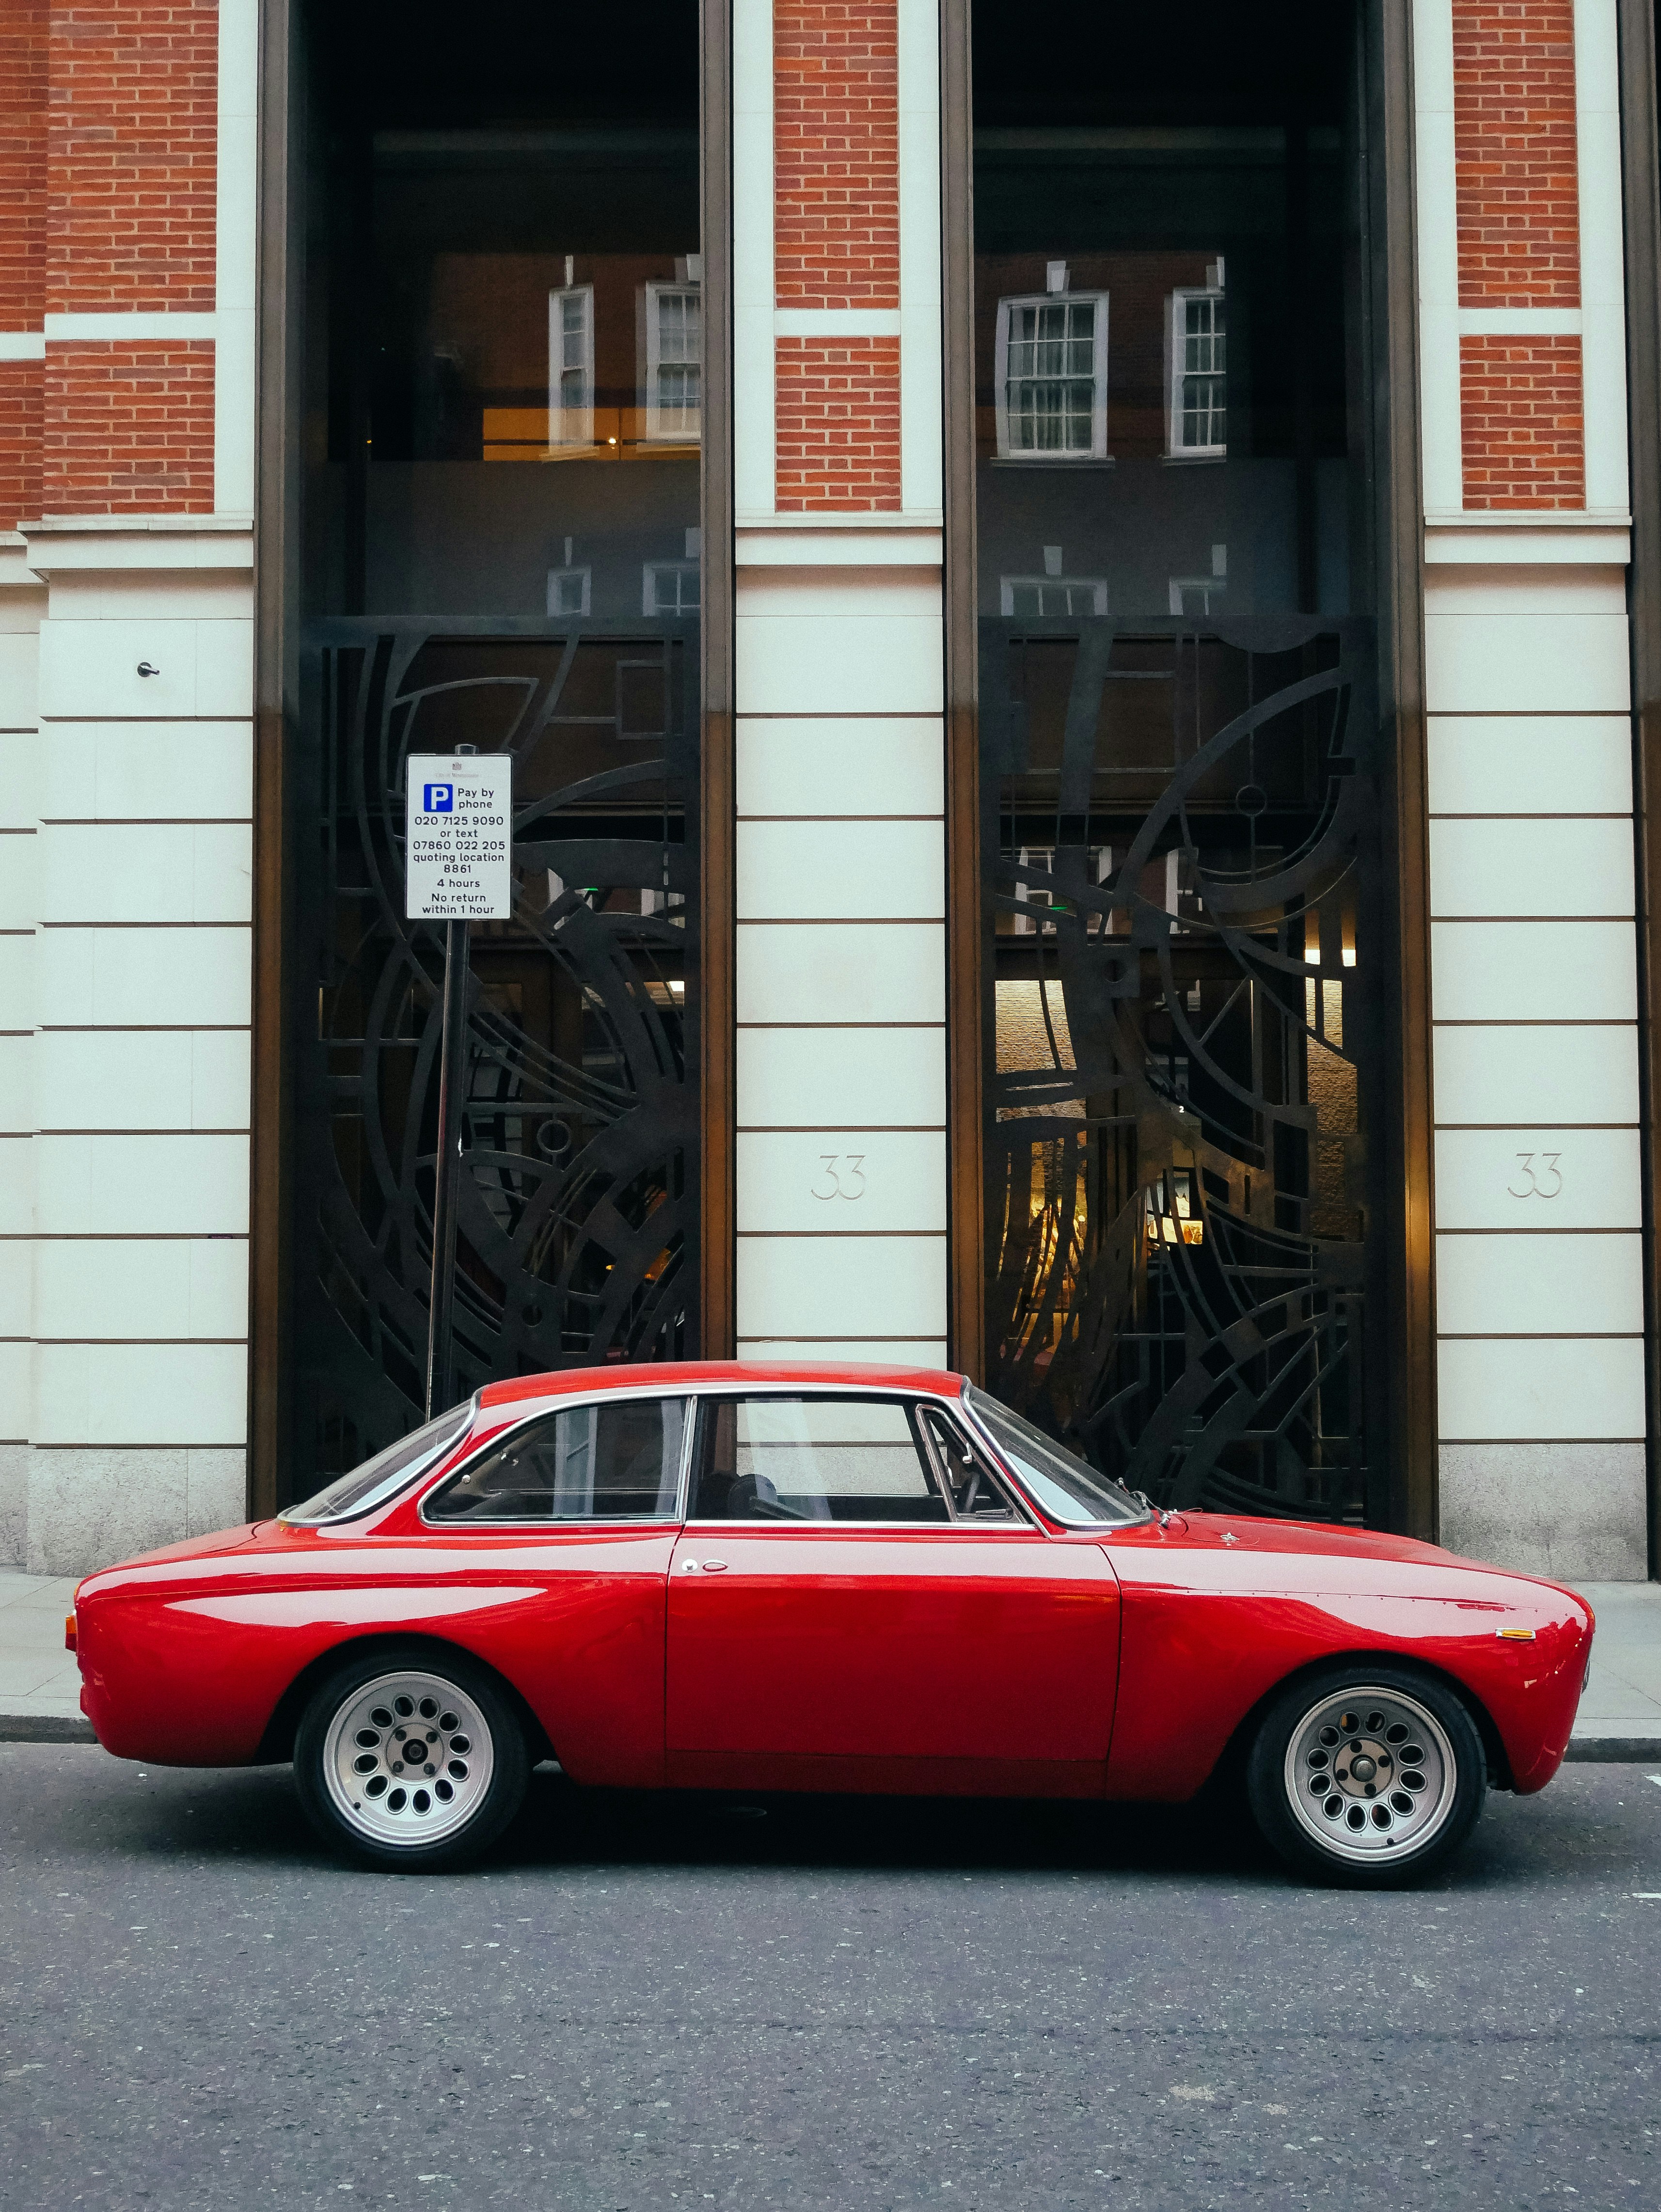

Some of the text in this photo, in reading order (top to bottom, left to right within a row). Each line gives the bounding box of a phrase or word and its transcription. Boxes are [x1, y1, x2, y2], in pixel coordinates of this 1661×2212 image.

[458, 788, 494, 798] Pay by
[430, 787, 449, 810] P
[459, 800, 493, 809] phone
[414, 816, 504, 826] 020 7125 9090
[455, 829, 478, 838] text
[413, 841, 506, 850] 07860 022 205
[413, 852, 505, 863] quoting location
[443, 864, 472, 874] 8861
[437, 879, 480, 888] 4 hours
[431, 893, 486, 903] No return
[422, 905, 495, 914] within 1 hour
[810, 1155, 867, 1200] 33
[1507, 1153, 1563, 1198] 33
